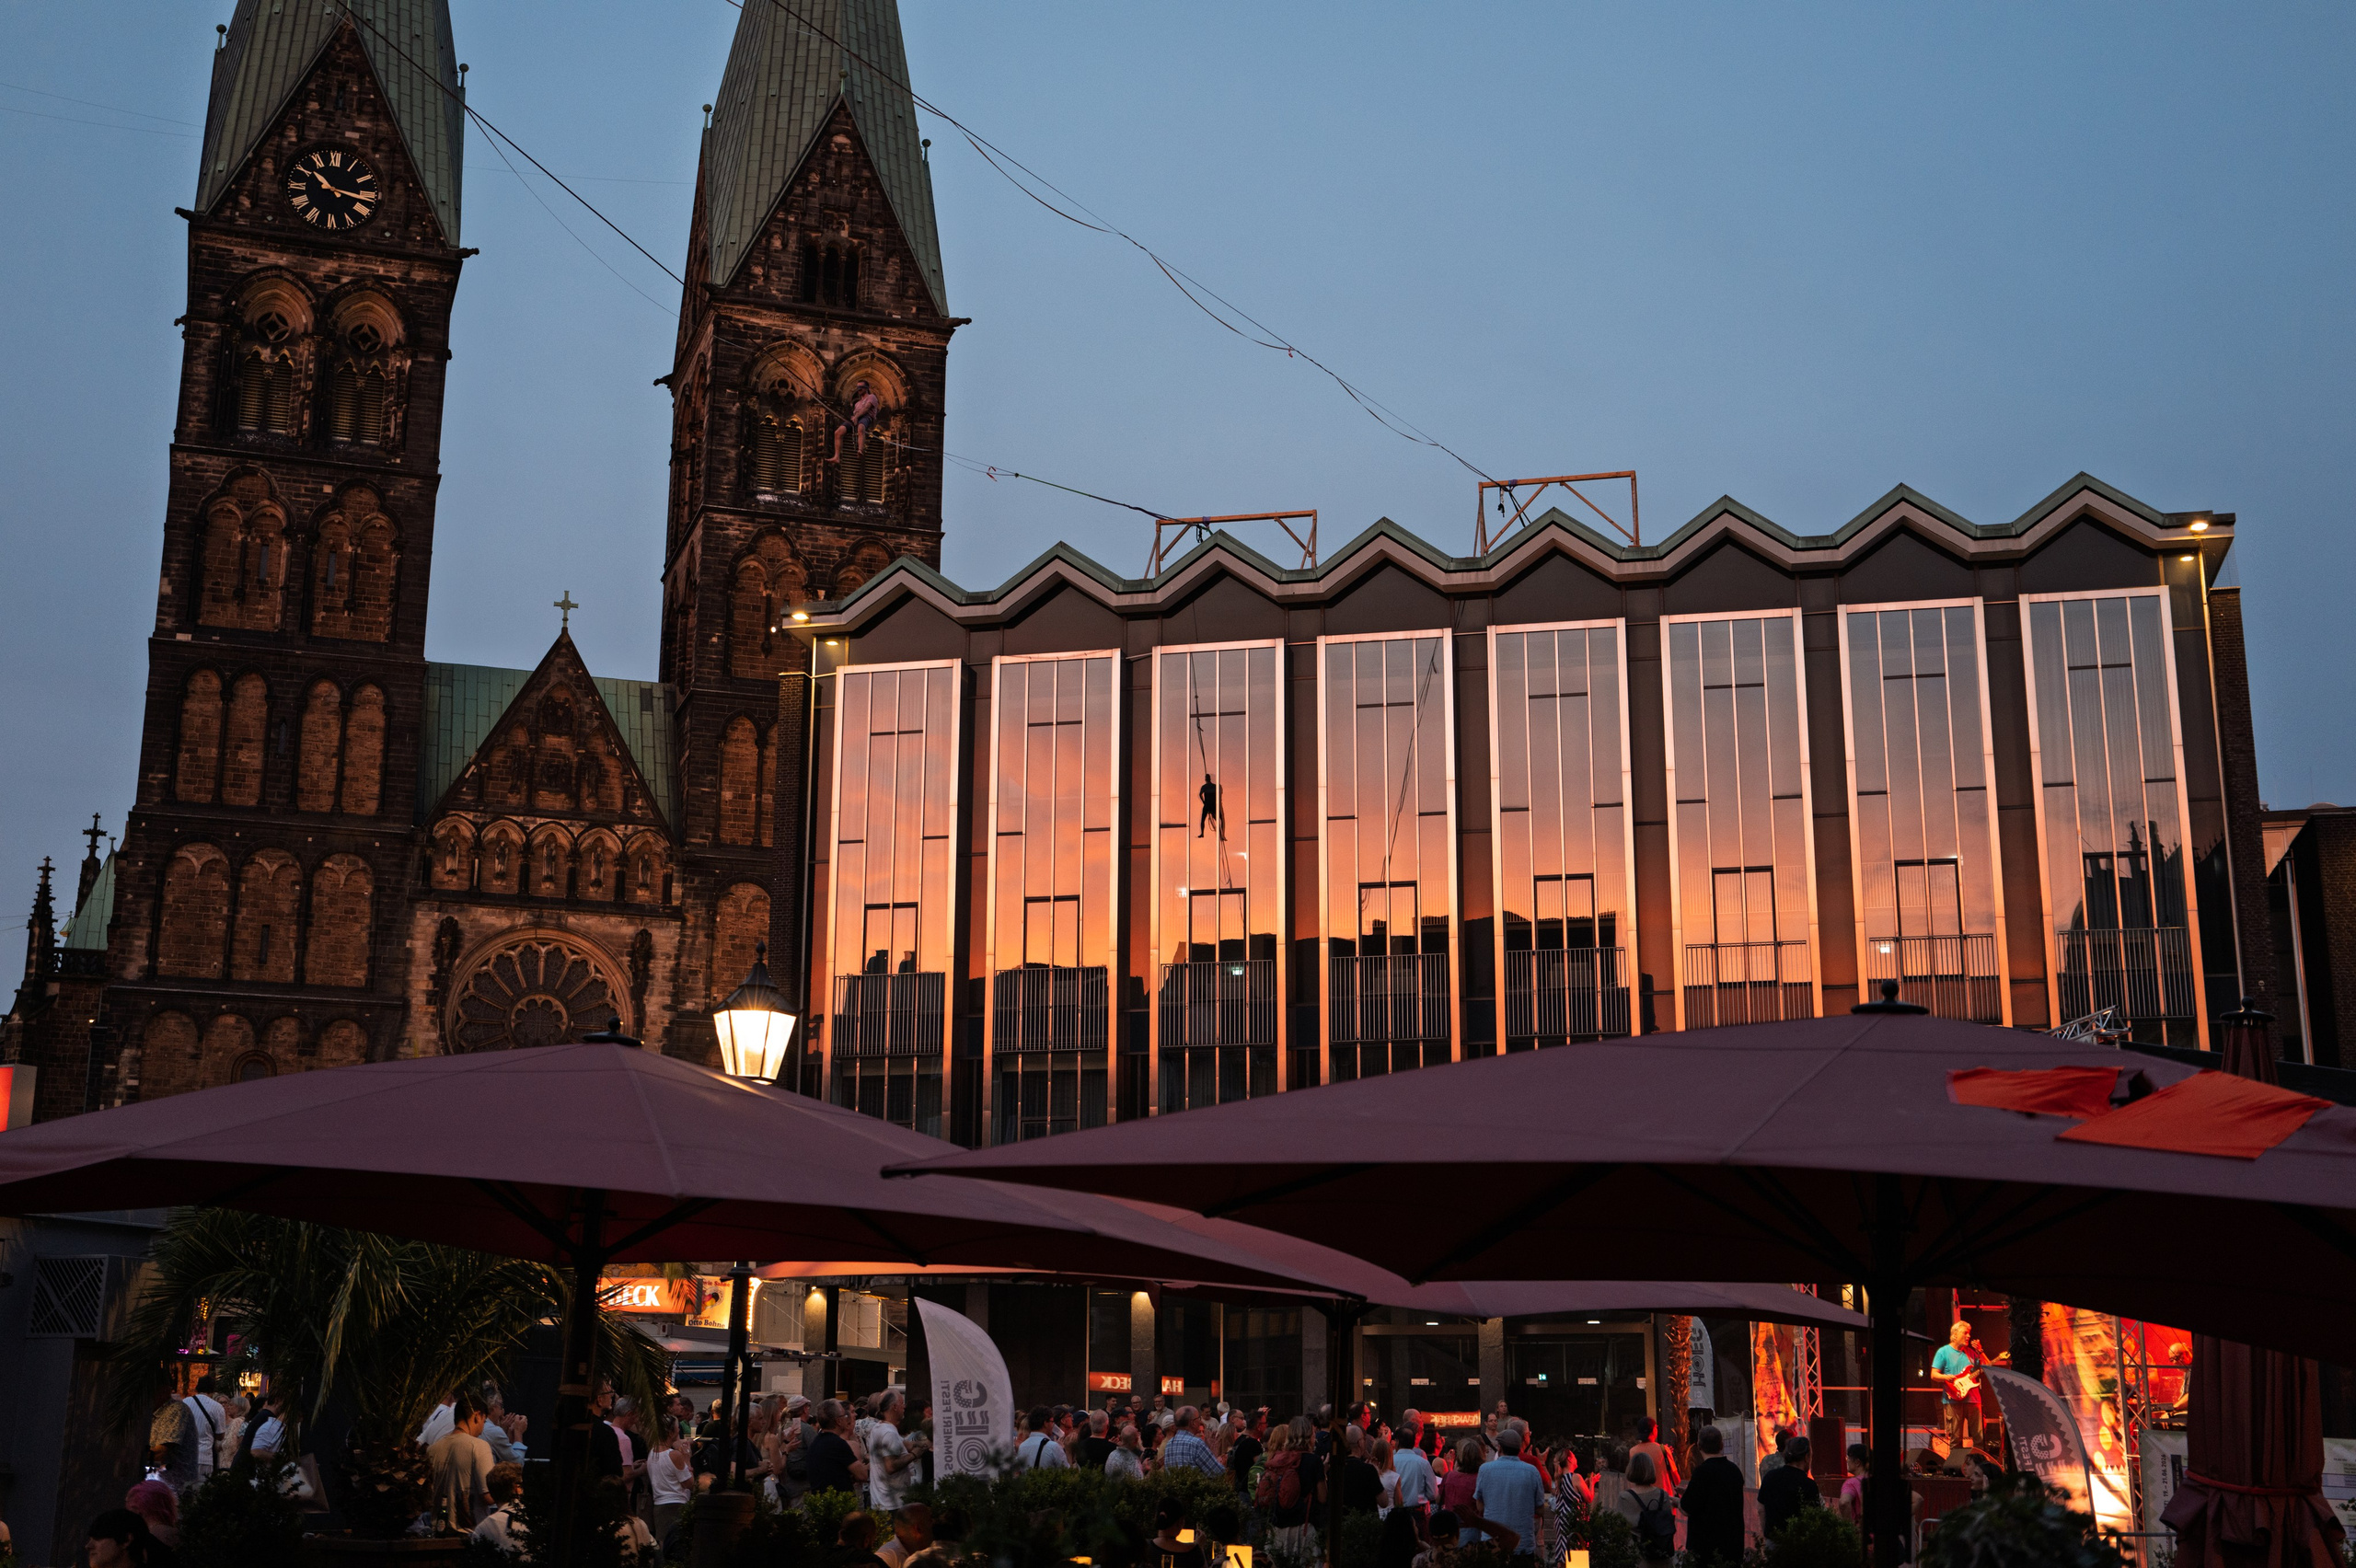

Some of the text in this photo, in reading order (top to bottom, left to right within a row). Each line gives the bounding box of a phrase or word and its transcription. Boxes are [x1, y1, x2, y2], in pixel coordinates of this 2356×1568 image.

[310, 153, 325, 169] XI
[329, 151, 342, 167] XII
[346, 158, 359, 172] I
[294, 164, 313, 178] X
[344, 212, 355, 226] V
